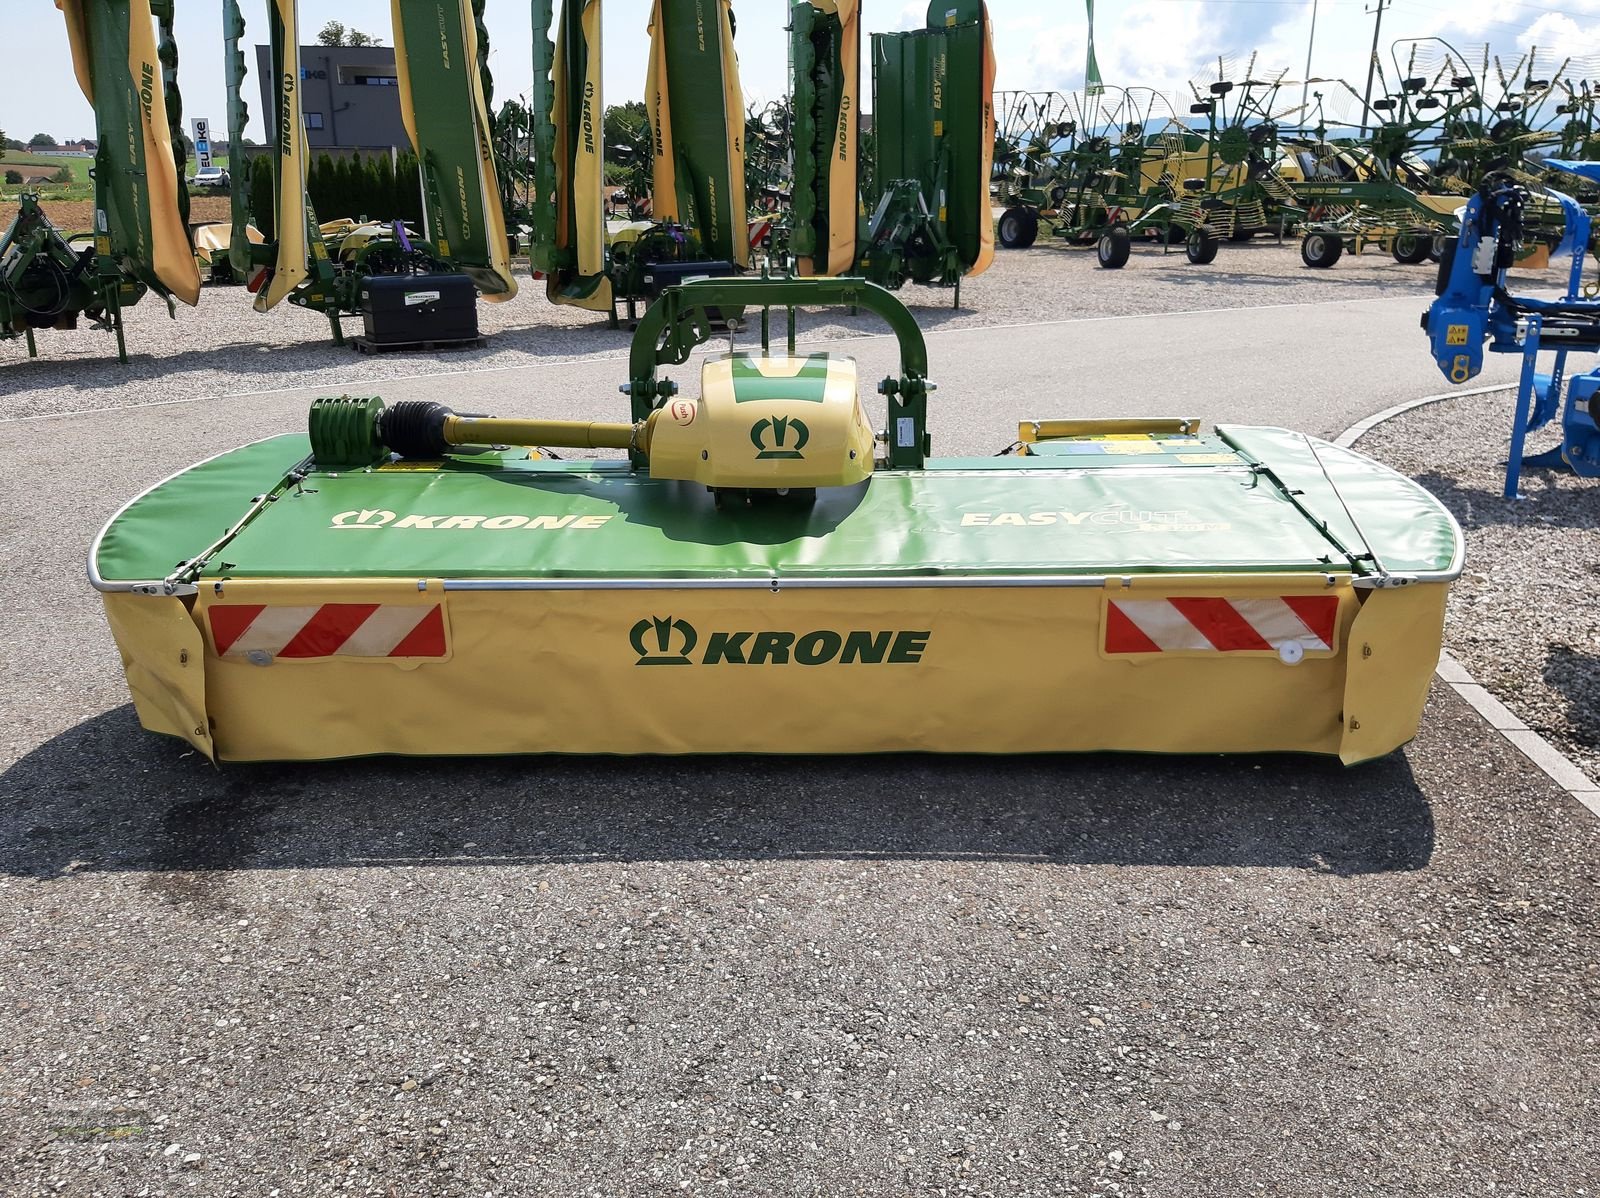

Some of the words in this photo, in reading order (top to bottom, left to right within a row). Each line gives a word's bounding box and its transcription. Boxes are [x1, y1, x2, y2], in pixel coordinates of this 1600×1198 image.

[283, 95, 291, 157] KRONE
[583, 101, 594, 154] KRONE
[839, 112, 848, 161] KRONE
[457, 166, 470, 223] KRONE
[708, 176, 717, 227] KRONE
[679, 403, 688, 419] Push
[390, 514, 613, 530] KRONE
[960, 511, 1188, 527] EASYCUT
[702, 630, 931, 665] KRONE
